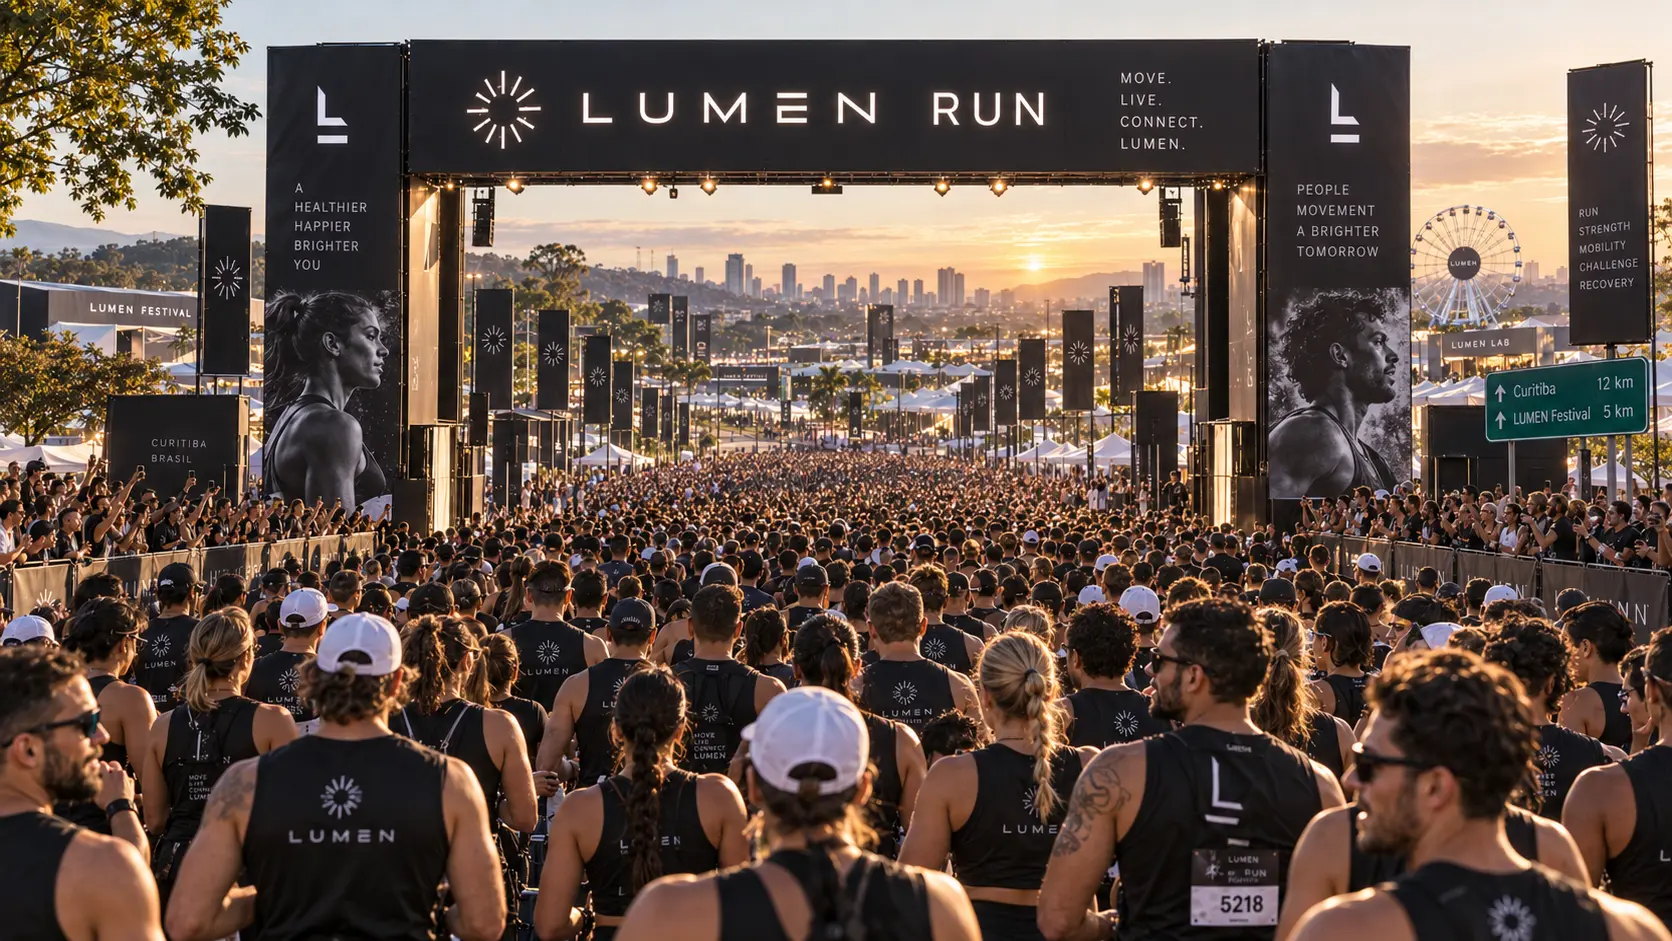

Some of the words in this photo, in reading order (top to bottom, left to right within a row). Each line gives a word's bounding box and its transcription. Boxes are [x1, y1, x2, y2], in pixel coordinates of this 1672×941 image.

[1121, 72, 1171, 83] MOVE.
[1121, 94, 1161, 105] LIVE.
[583, 92, 875, 124] LUMEN
[933, 92, 1044, 126] RUN
[1121, 116, 1202, 128] CONNECT.
[1121, 138, 1184, 149] LUMEN.
[295, 183, 303, 193] A
[1298, 184, 1349, 195] PEOPLE
[295, 202, 367, 212] HEALTHIER
[1297, 205, 1375, 216] MOVEMENT
[1579, 207, 1598, 217] RUN
[295, 221, 350, 232] HAPPIER
[1297, 226, 1305, 236] A
[1312, 226, 1379, 236] BRIGHTER
[1579, 221, 1630, 236] STRENGTH
[295, 240, 358, 251] BRIGHTER
[1580, 241, 1625, 254] MOBILITY
[1297, 246, 1378, 257] TOMORROW
[294, 259, 320, 270] YOU
[1580, 258, 1638, 272] CHALLENGE
[1580, 278, 1634, 289] RECOVERY
[90, 303, 133, 314] LUMEN
[141, 306, 191, 317] FESTIVAL
[1452, 340, 1485, 349] LUMEN
[1491, 339, 1509, 347] LAB
[1514, 382, 1555, 397] Curitiba
[1598, 377, 1610, 390] 12
[1615, 376, 1633, 389] km
[1514, 410, 1548, 424] LUMEN
[1552, 406, 1590, 421] Festival
[1604, 405, 1611, 418] 5
[1615, 404, 1633, 417] km
[152, 439, 206, 448] CURITIBA
[152, 454, 191, 463] BRASIL
[144, 660, 176, 669] LUMEN
[527, 668, 570, 676] LUMEN
[882, 708, 933, 718] LUMEN
[694, 752, 726, 760] LUMEN
[289, 829, 394, 843] LUMEN
[1228, 855, 1259, 864] LUMEN
[1244, 869, 1267, 877] RUN
[1220, 895, 1264, 913] 5218
